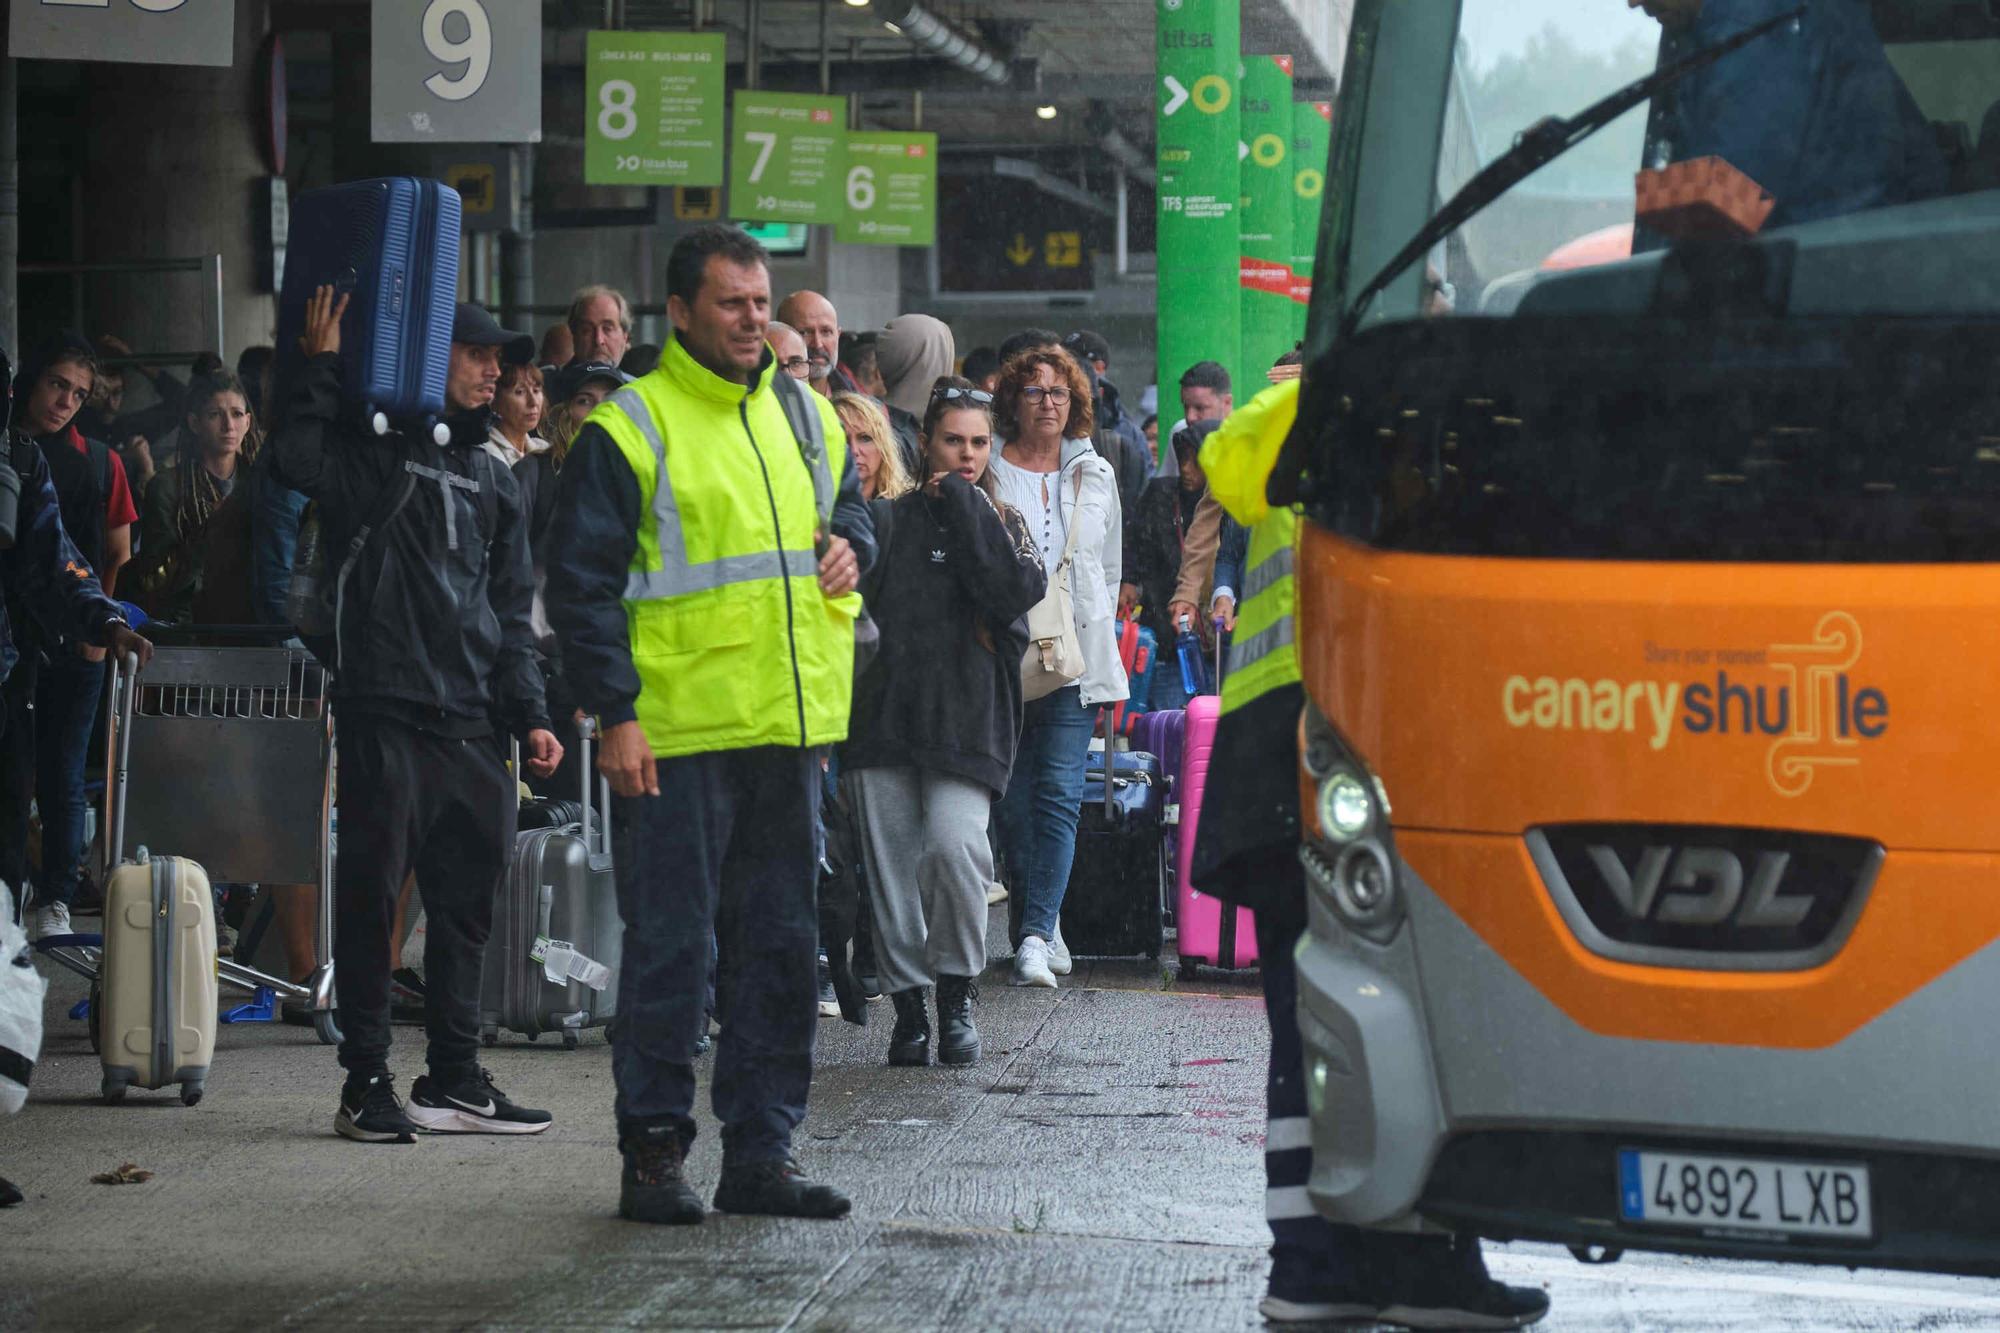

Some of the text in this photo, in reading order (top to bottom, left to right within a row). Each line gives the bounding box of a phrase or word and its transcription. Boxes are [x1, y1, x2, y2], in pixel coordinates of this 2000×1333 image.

[420, 0, 493, 101] 9
[598, 79, 637, 140] 8
[745, 131, 776, 184] 7
[846, 165, 875, 210] 6
[1586, 844, 1816, 927] VDL
[1654, 1162, 1859, 1225] 4892 LXB
